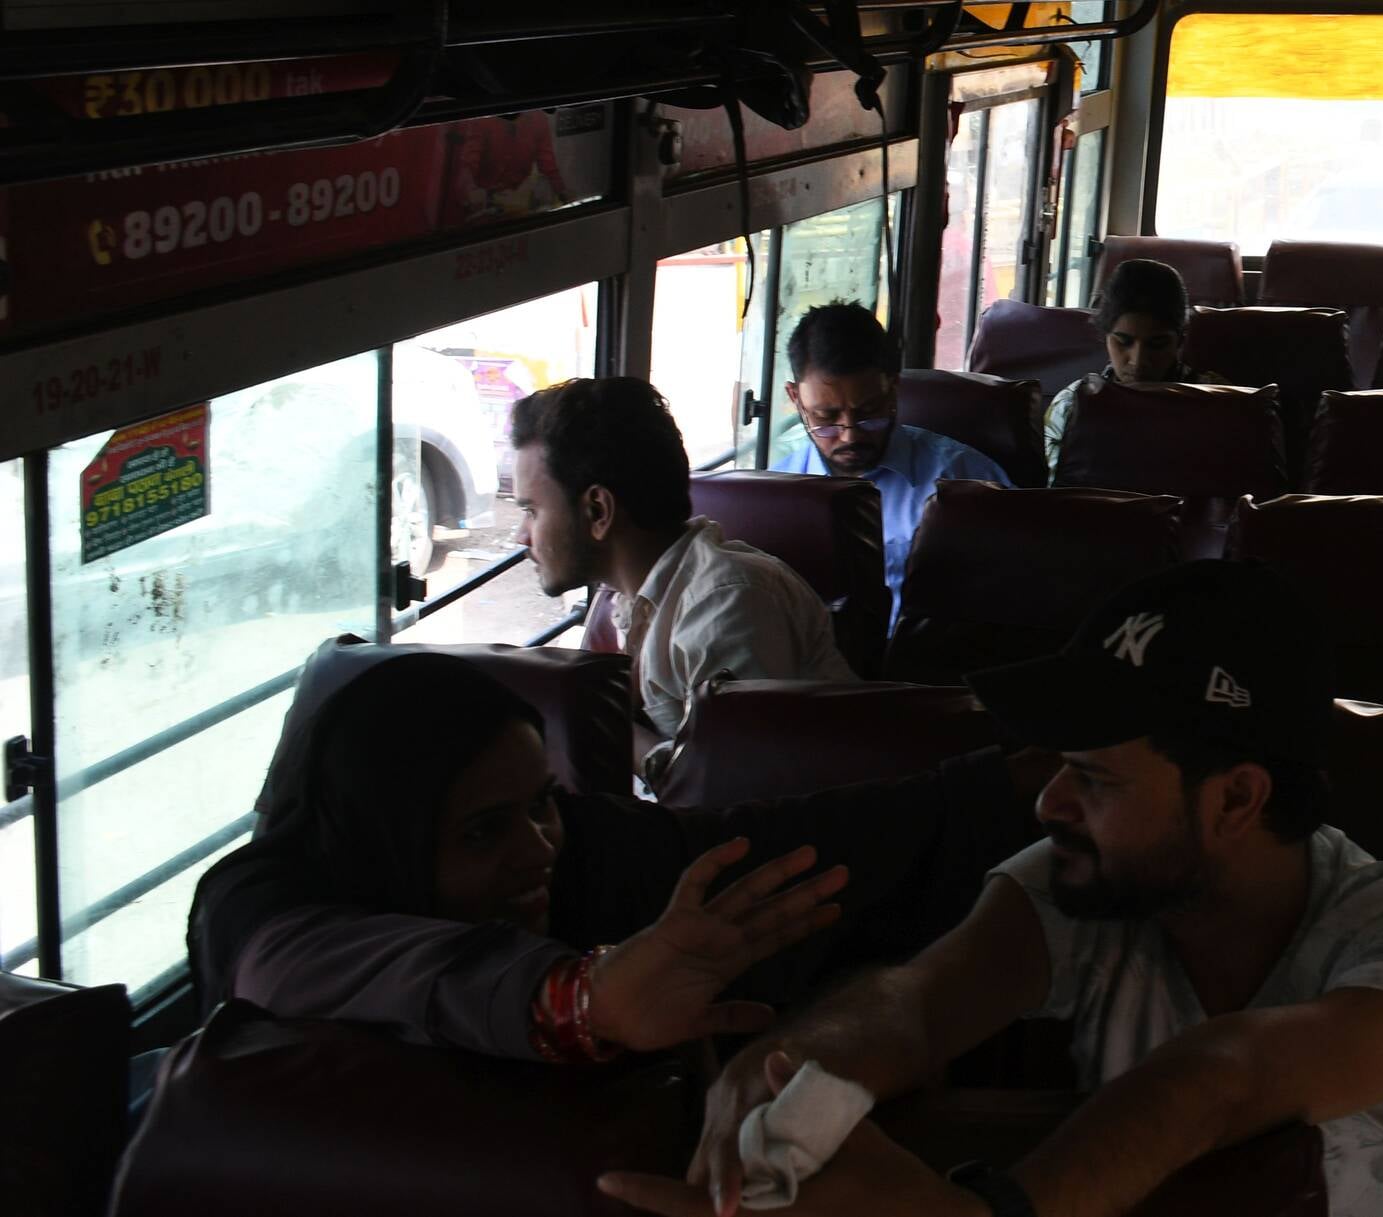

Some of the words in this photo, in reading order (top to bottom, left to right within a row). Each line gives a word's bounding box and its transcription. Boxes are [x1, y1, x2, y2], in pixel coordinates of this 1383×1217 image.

[285, 67, 325, 97] tak
[123, 167, 401, 260] 89200-89200
[33, 346, 161, 416] 19-20-21-W
